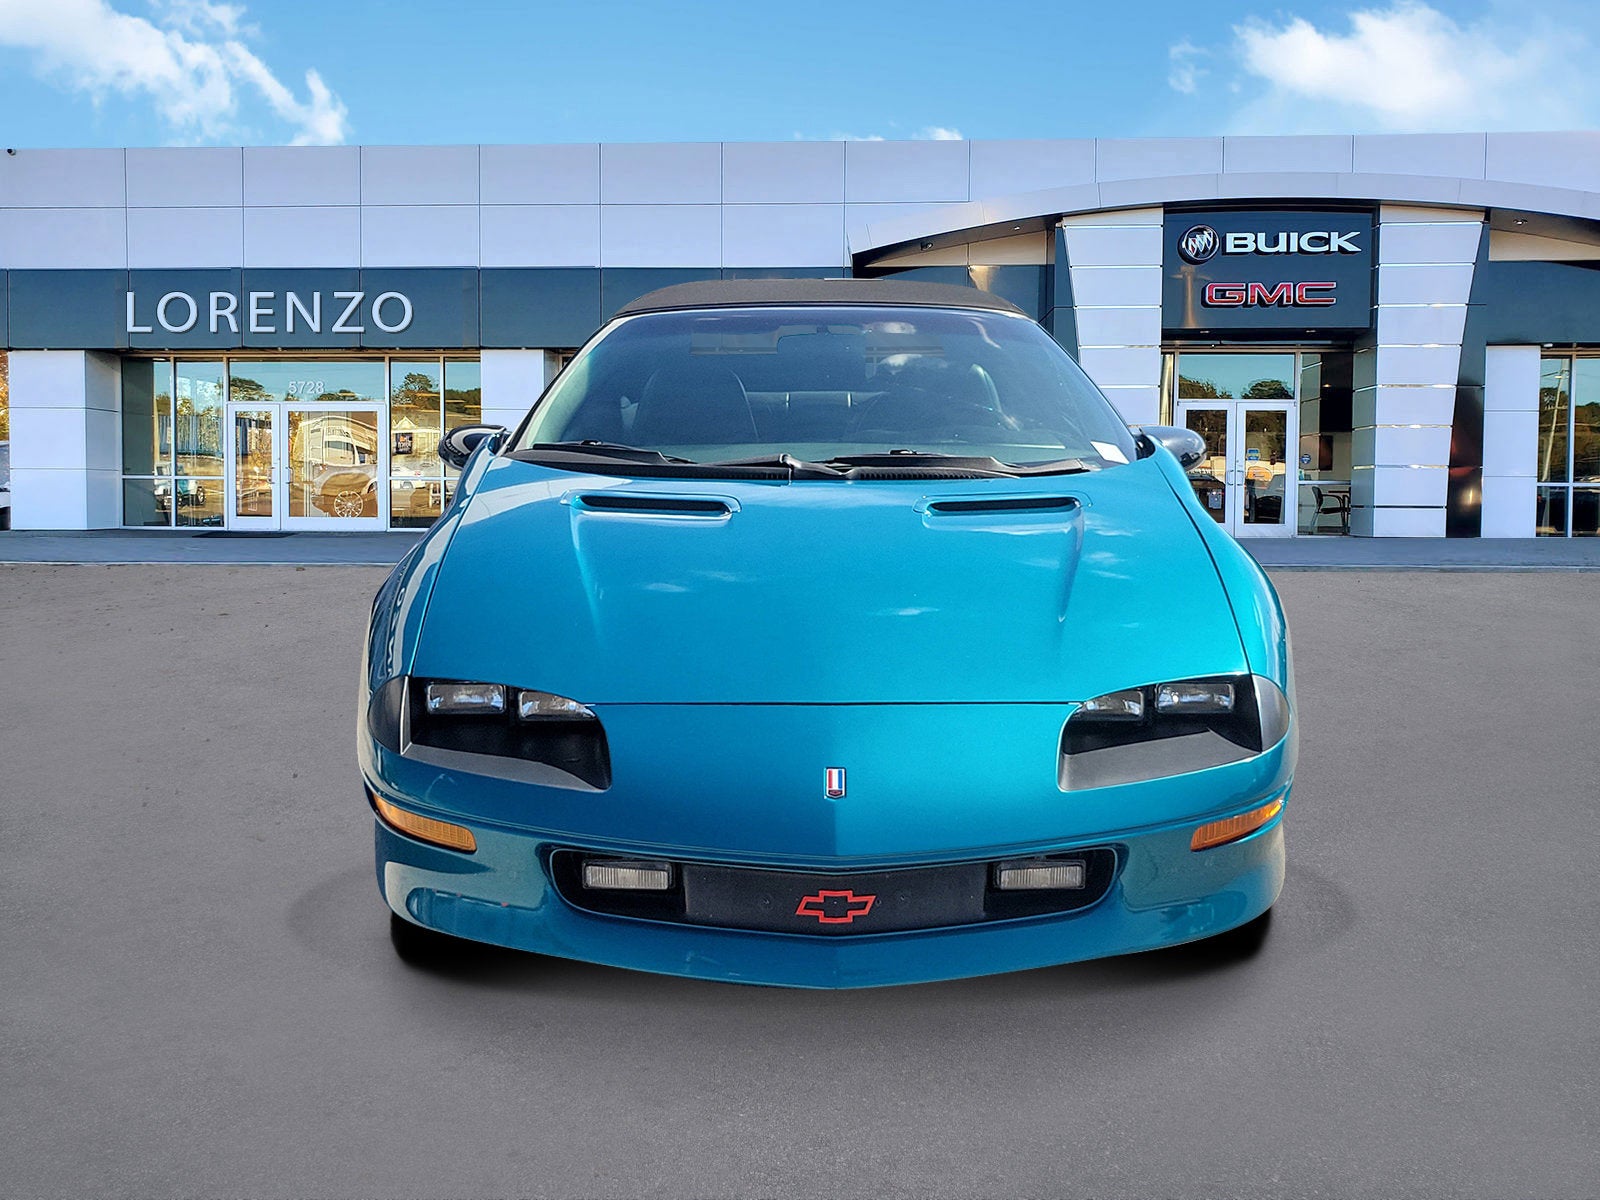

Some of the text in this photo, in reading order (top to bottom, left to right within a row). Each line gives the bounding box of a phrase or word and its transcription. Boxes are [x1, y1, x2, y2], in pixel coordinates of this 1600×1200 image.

[1225, 231, 1362, 253] BUICK
[1205, 281, 1337, 305] GMC
[126, 291, 414, 333] LORENZO
[288, 381, 326, 395] 5728
